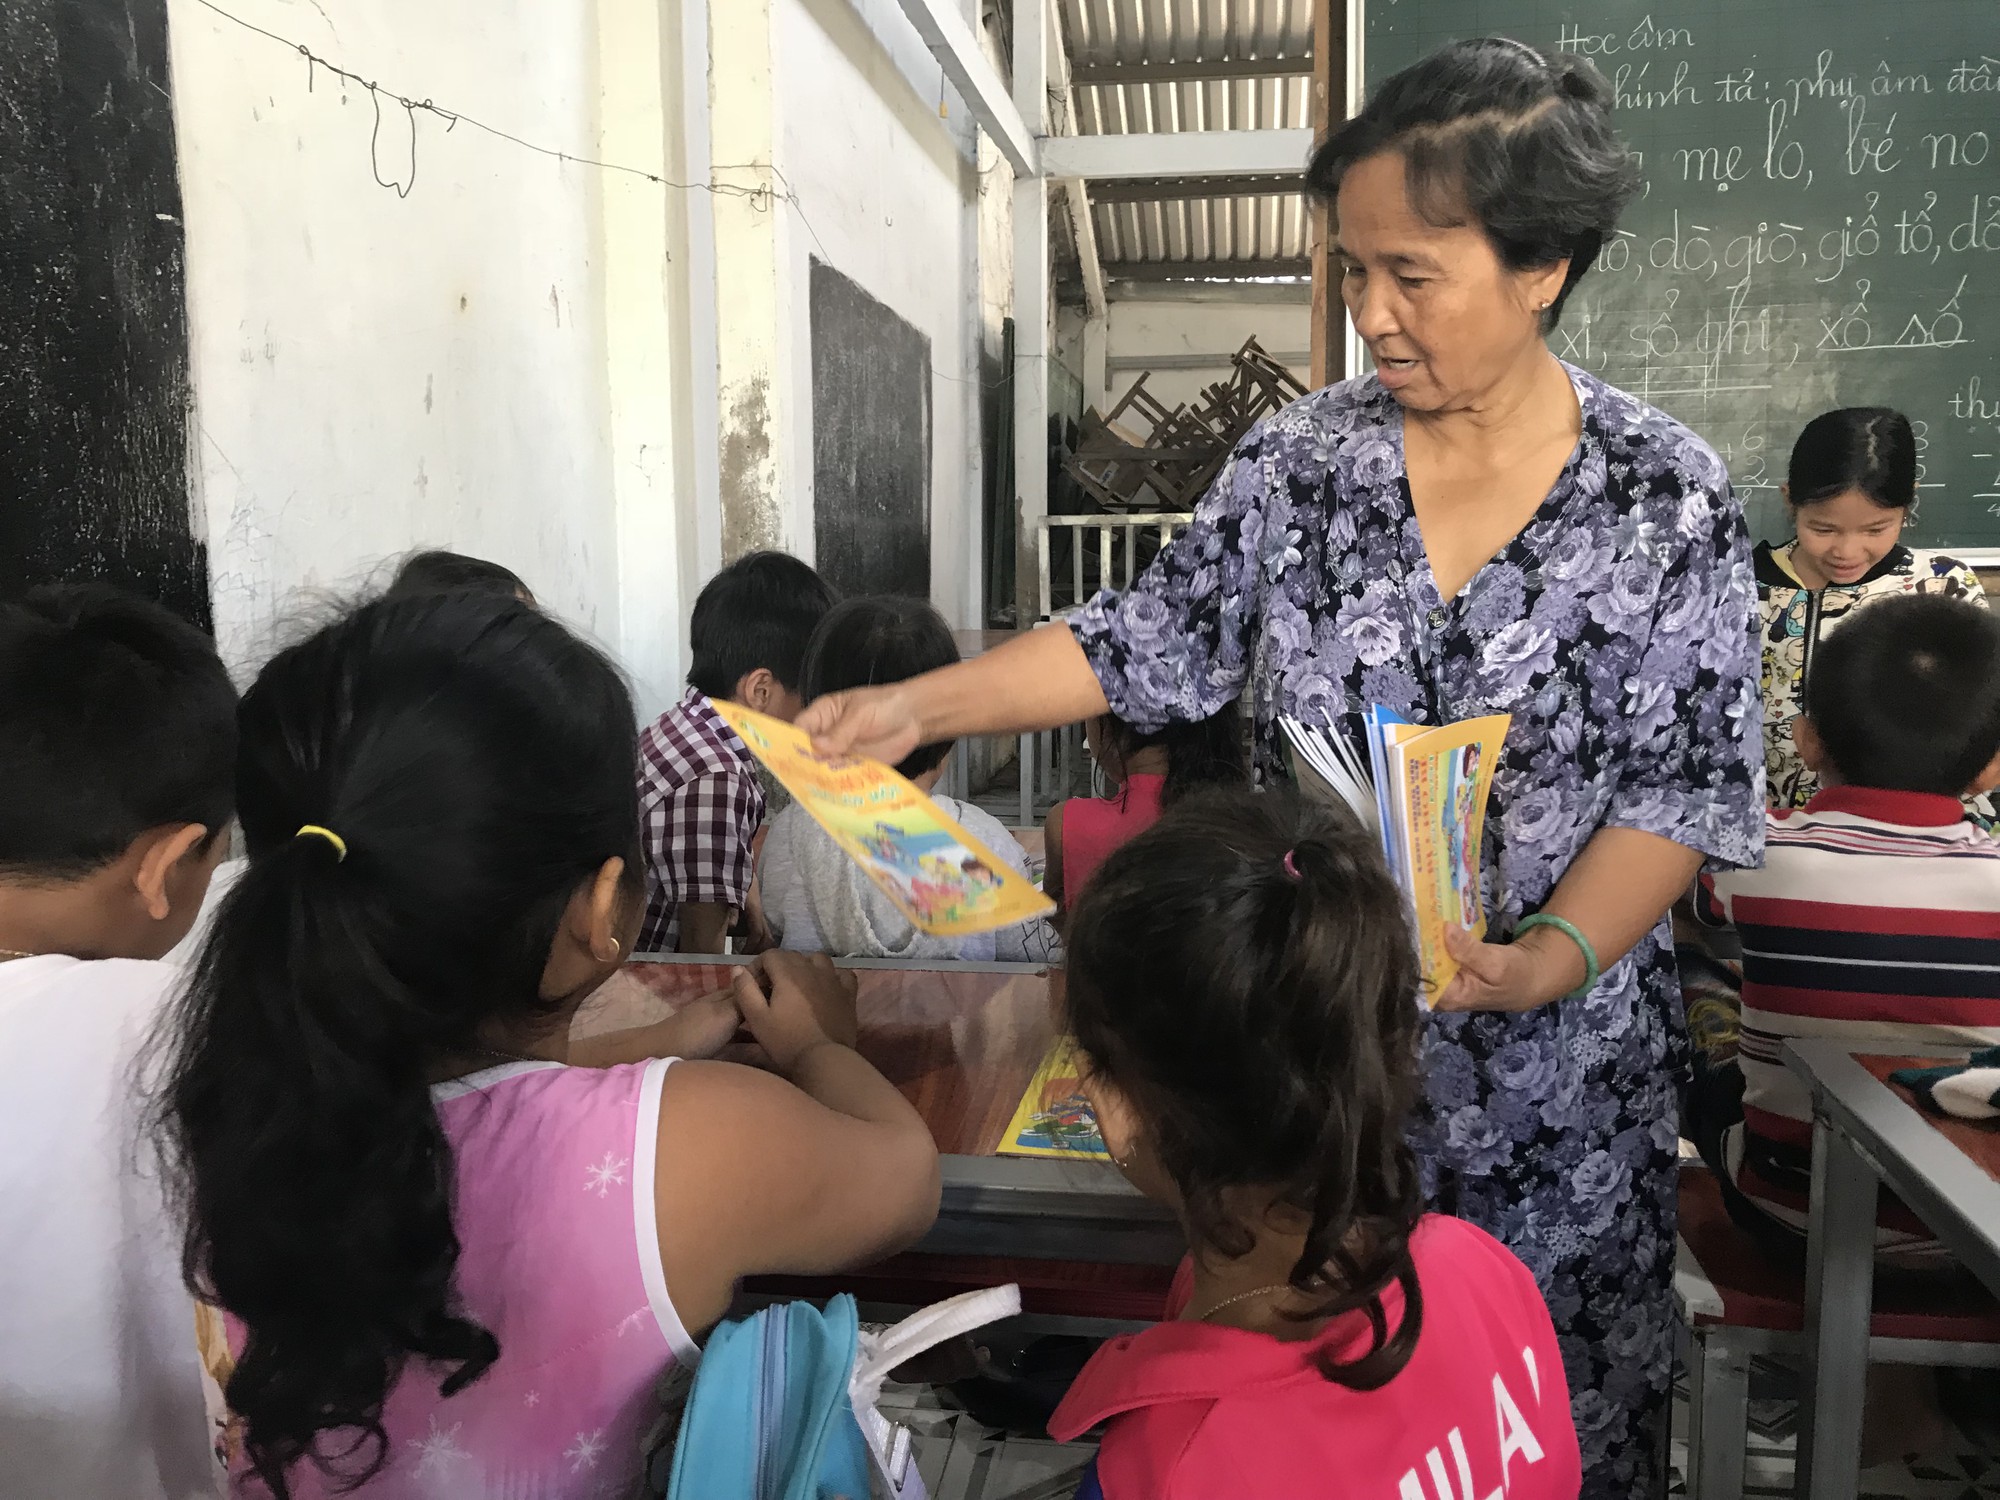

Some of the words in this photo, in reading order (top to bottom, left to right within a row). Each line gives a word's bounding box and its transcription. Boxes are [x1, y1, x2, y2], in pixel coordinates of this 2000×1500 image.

[1627, 14, 1696, 51] âm
[1614, 60, 1703, 110] hính
[1871, 59, 1934, 96] âm
[1673, 145, 1751, 192] mẹ
[1762, 99, 1813, 191] lo,
[1846, 94, 1901, 175] bé
[1920, 131, 1989, 169] no
[1742, 420, 1764, 451] 6
